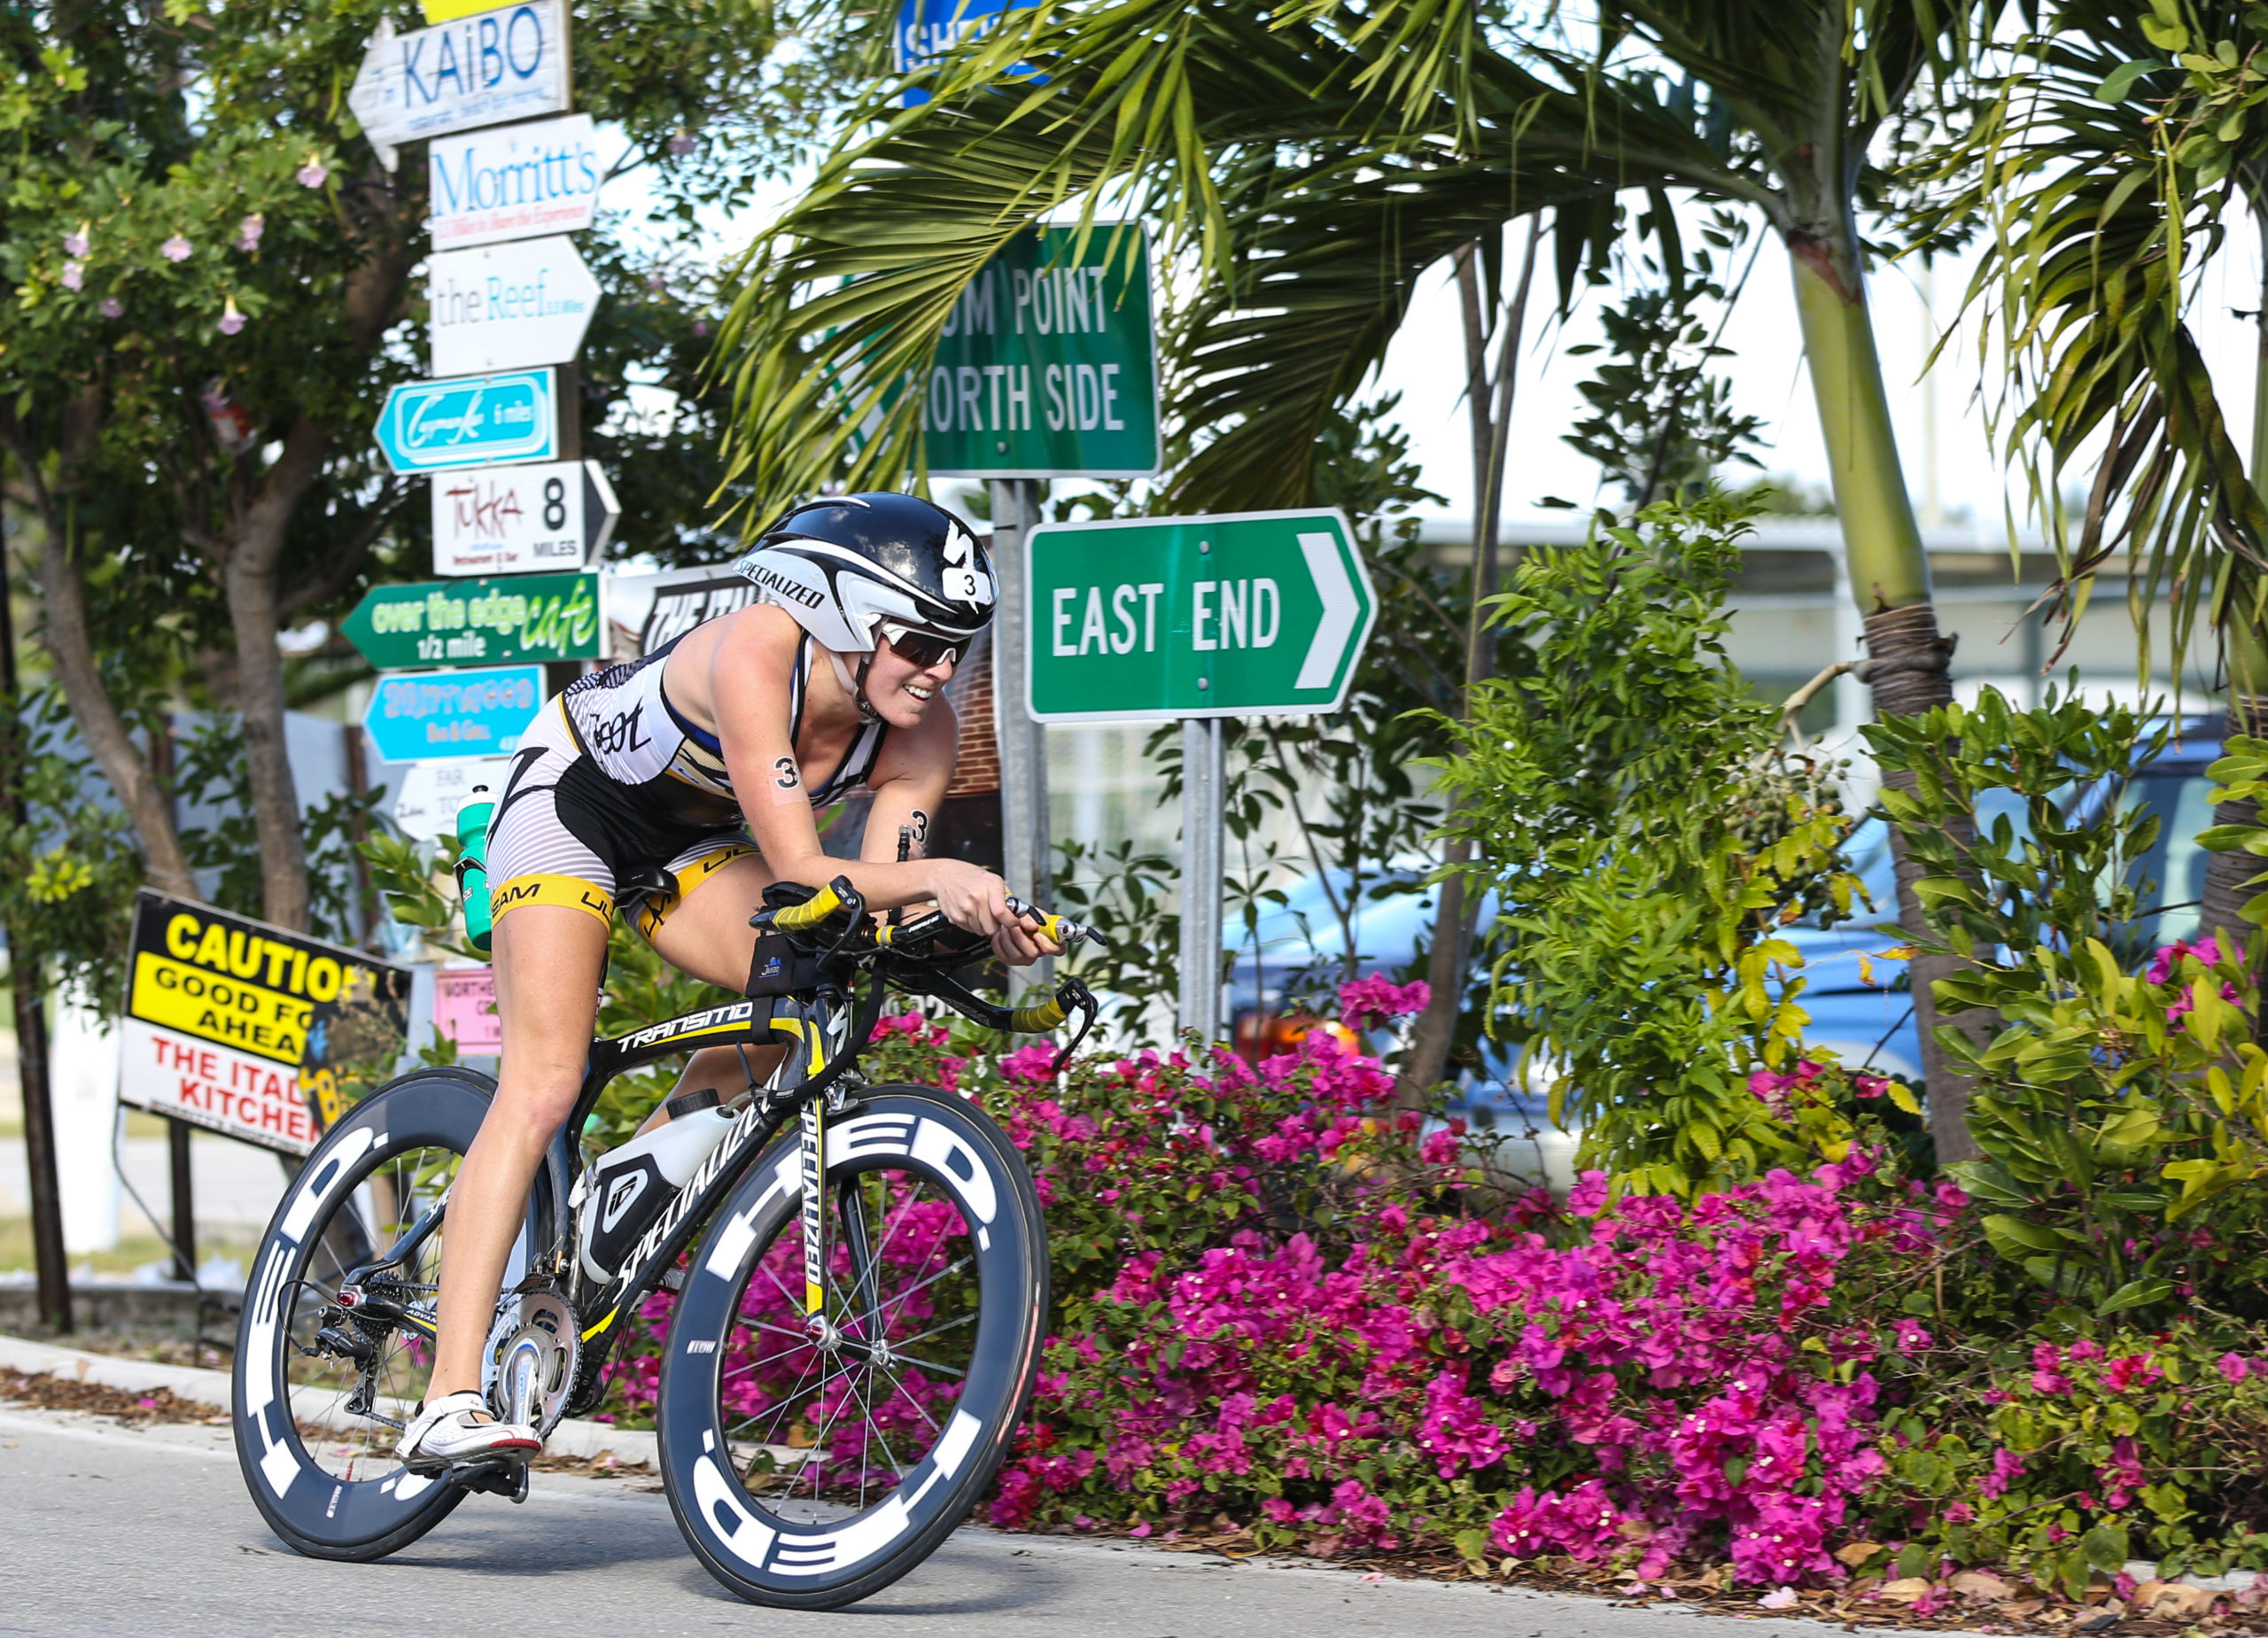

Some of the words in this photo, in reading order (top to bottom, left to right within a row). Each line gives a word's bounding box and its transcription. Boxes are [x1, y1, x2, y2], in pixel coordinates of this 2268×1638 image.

[431, 142, 597, 218] Morritt's
[438, 278, 481, 327] the
[486, 268, 548, 321] Reef
[1016, 267, 1108, 335] POINT
[1045, 363, 1124, 431] SIDE
[543, 477, 566, 532] 8
[533, 540, 577, 557] MILES
[735, 559, 826, 610] SPECIALIZED
[964, 574, 976, 596] 3
[372, 601, 425, 634] over
[427, 591, 466, 631] the
[468, 587, 528, 635] edge
[1052, 583, 1164, 656] EAST
[1192, 578, 1280, 651] END
[417, 634, 443, 660] 1/2
[447, 630, 486, 658] mile
[773, 755, 799, 790] 3
[912, 809, 928, 844] 3
[492, 883, 541, 918] EAM
[155, 966, 259, 1014] GOOD
[275, 1002, 313, 1031] FO
[198, 1009, 298, 1055] AHEA
[617, 1001, 753, 1053] TRANSITIO
[151, 1036, 219, 1081] THE
[180, 1076, 319, 1142] KITCHE
[800, 1097, 822, 1285] SPECIALIZED
